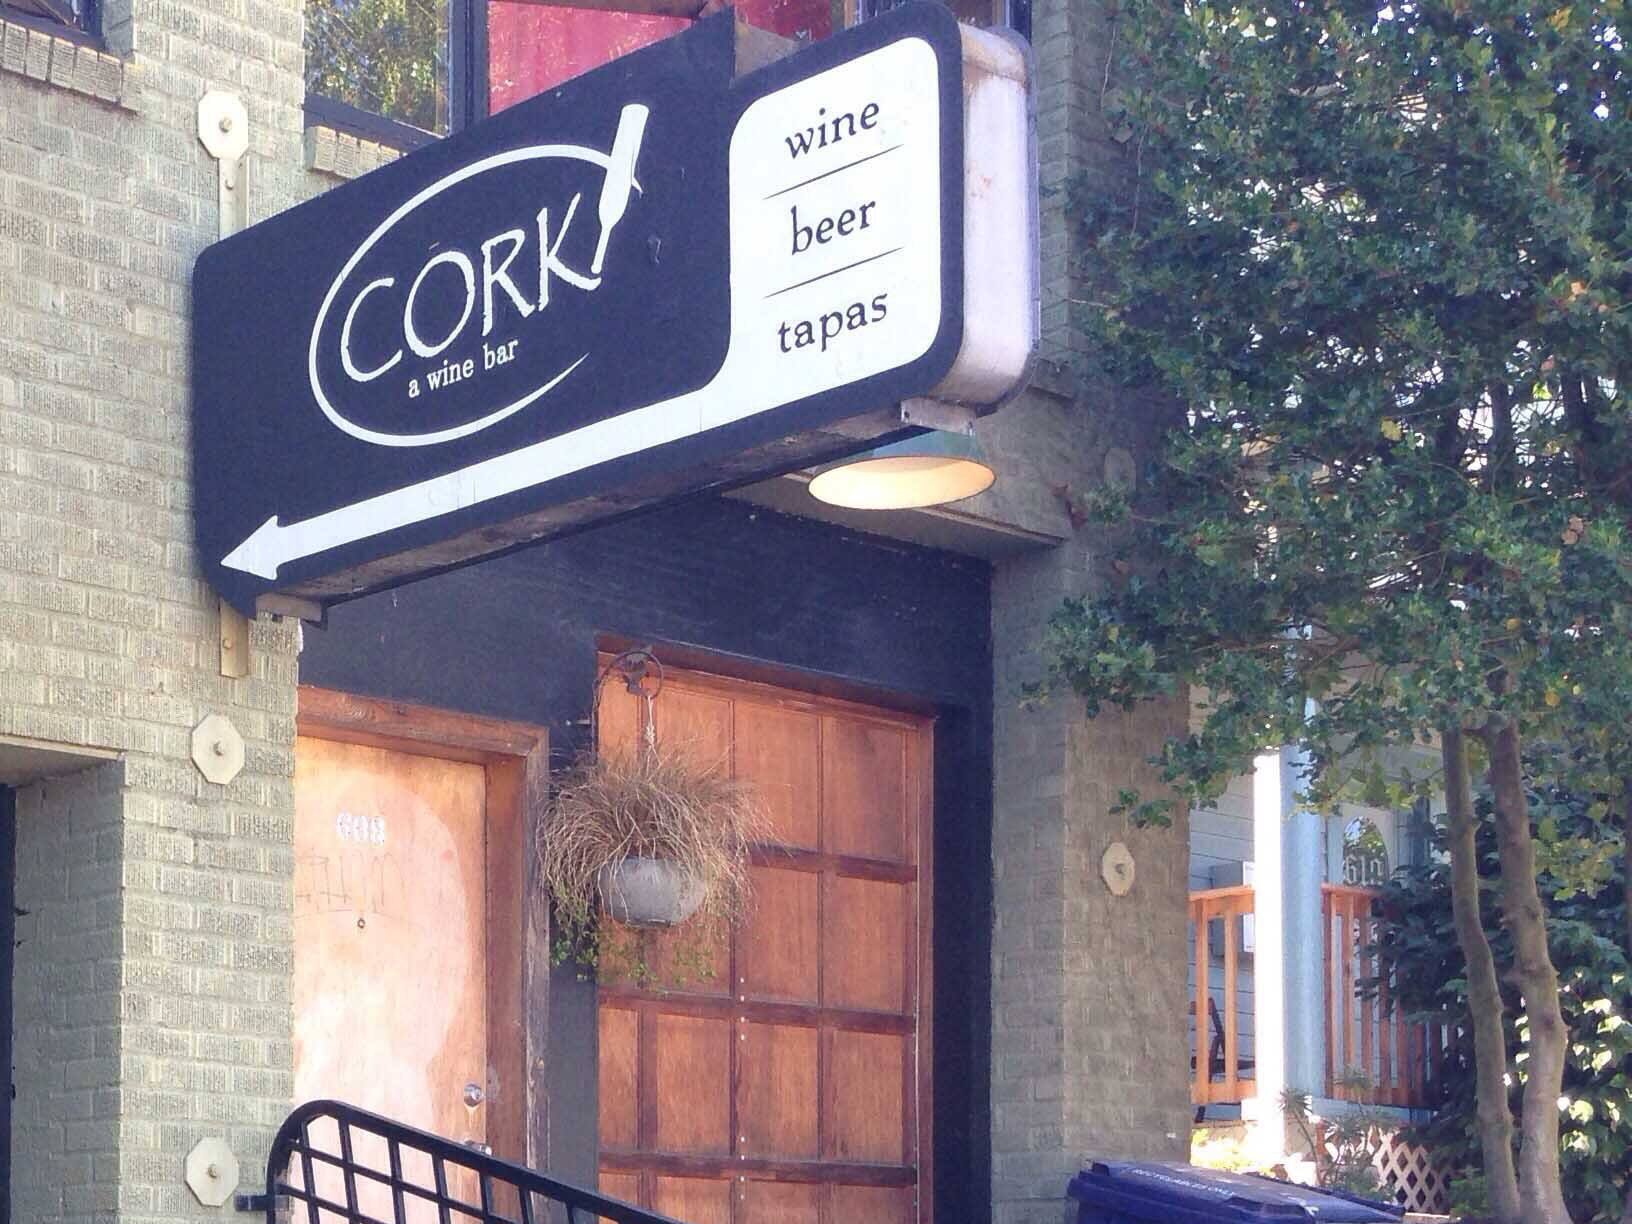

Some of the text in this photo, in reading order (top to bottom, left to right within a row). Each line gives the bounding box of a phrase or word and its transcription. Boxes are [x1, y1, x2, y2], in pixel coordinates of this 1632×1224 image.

[785, 102, 880, 159] wine
[790, 200, 876, 255] beer
[778, 293, 888, 353] tapas
[407, 339, 519, 398] a wine bar
